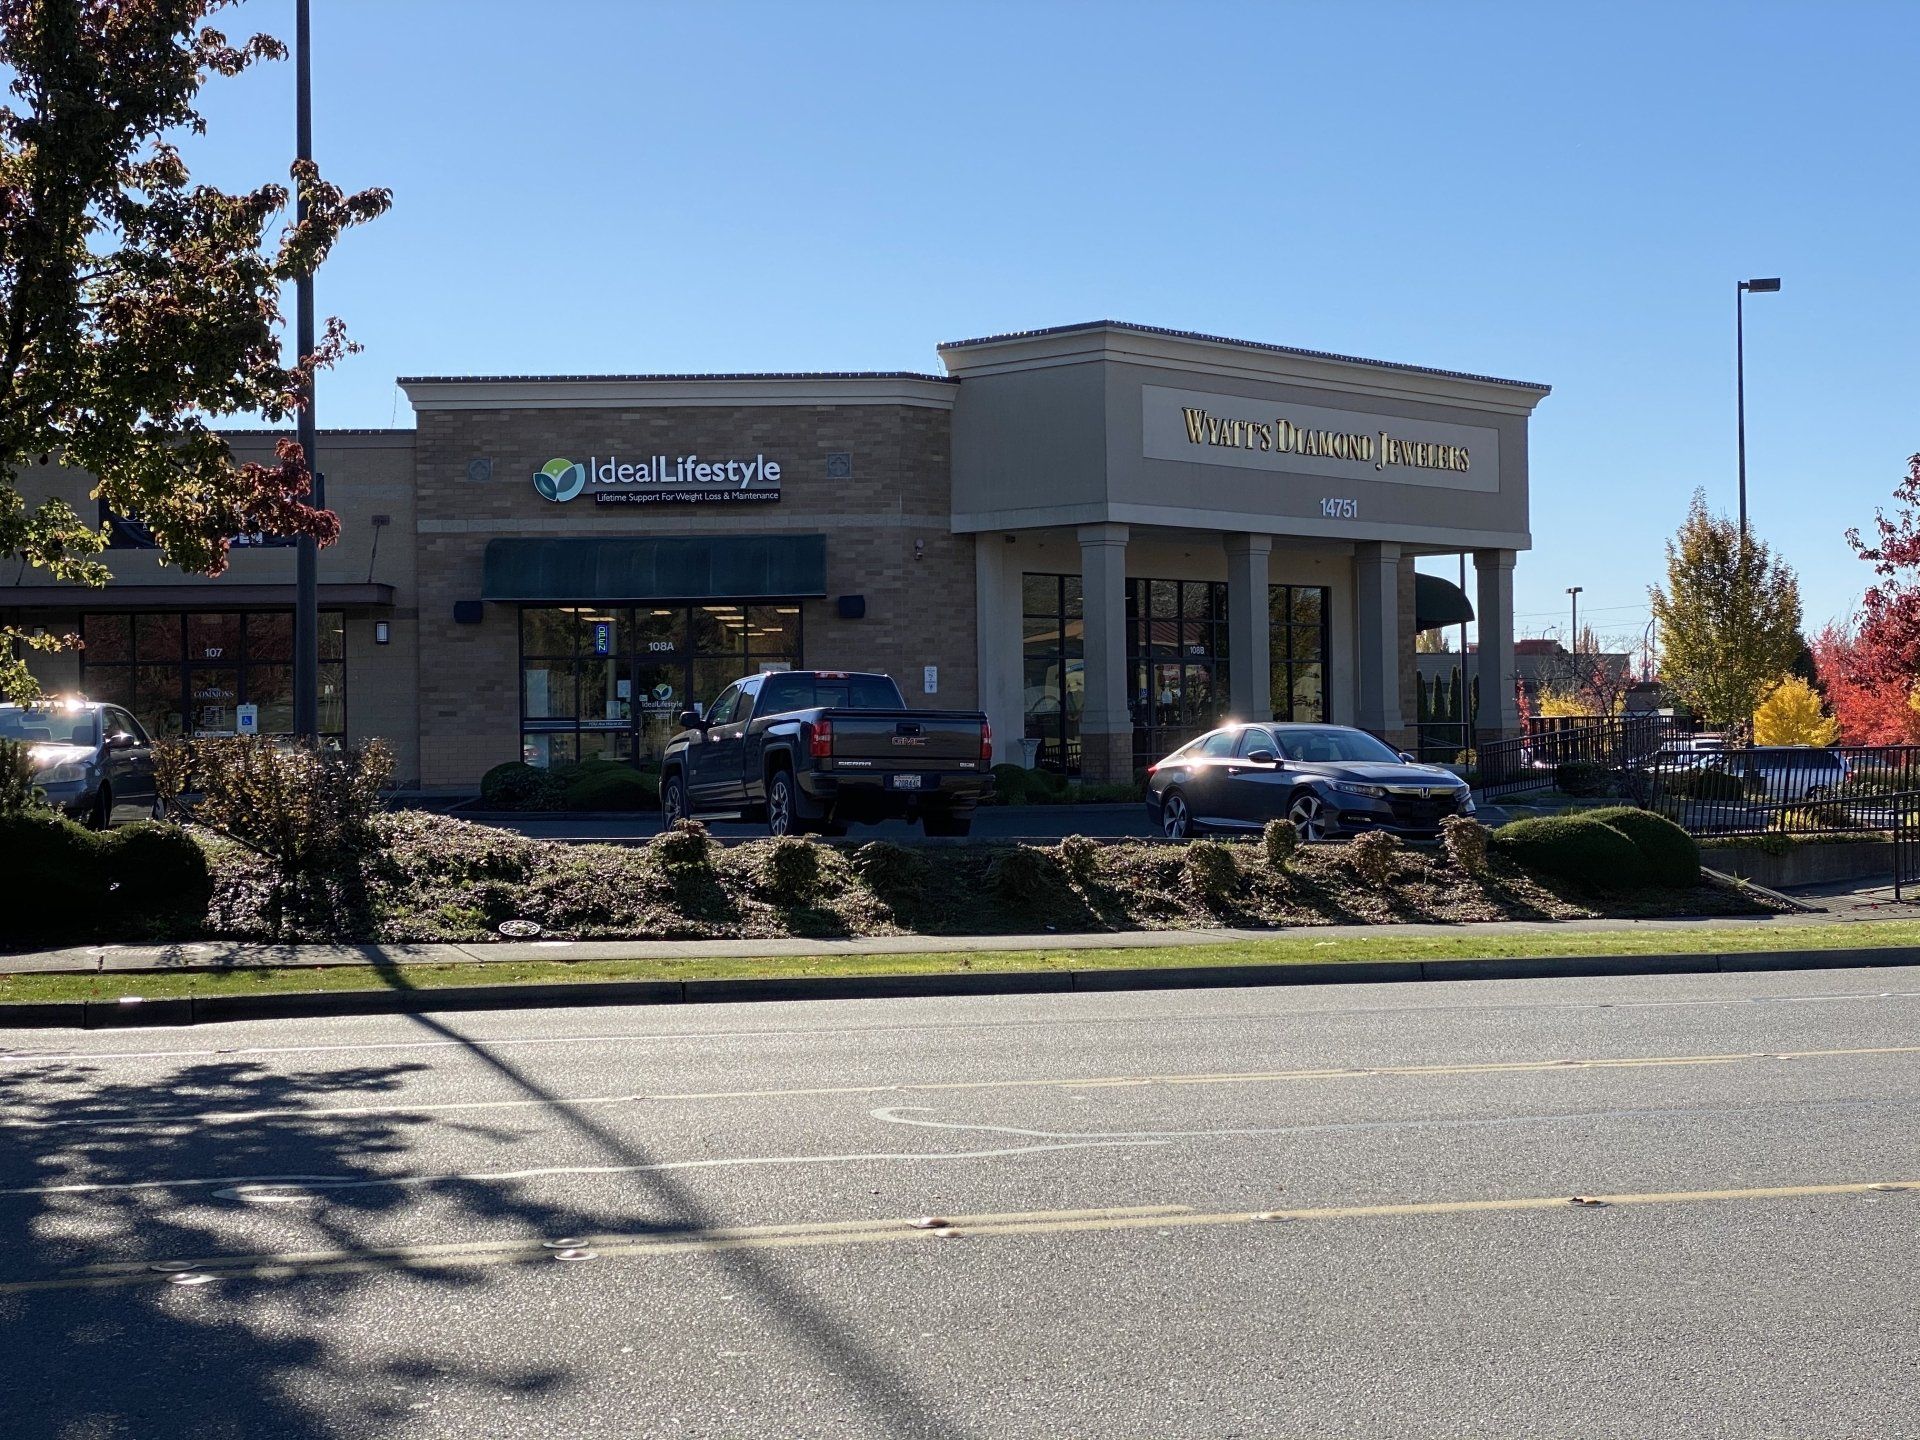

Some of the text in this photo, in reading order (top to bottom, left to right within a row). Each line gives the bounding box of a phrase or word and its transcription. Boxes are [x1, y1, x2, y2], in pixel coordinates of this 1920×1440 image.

[1182, 406, 1470, 472] WYATT'S DIAMOND JEWELERS
[590, 454, 781, 489] IdealLifestyle
[597, 491, 779, 503] Lifetime Support For Weight Loss & Maintenance
[1319, 498, 1358, 518] 14751
[598, 626, 606, 651] OPEN
[648, 641, 675, 651] 108A
[1189, 646, 1205, 655] 108B
[204, 648, 223, 658] 107
[891, 736, 928, 746] GMC
